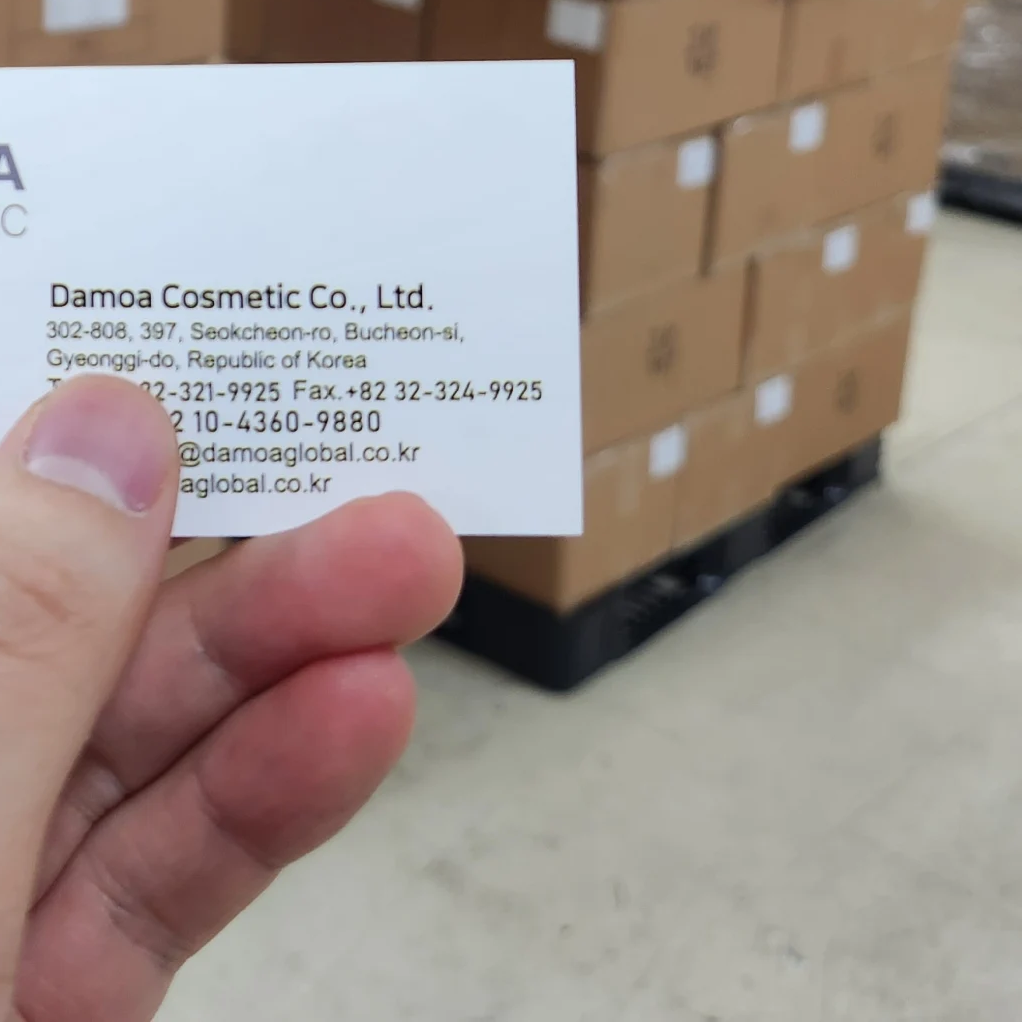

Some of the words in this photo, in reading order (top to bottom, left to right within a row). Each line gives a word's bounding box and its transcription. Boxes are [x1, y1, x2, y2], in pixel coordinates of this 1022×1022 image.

[51, 283, 153, 309] Damoa
[161, 281, 301, 310] Cosmetic
[309, 283, 366, 314] Co.,
[377, 283, 433, 310] Ltd.
[46, 321, 133, 343] 302-808,
[140, 321, 183, 343] 397,
[190, 321, 337, 344] Seokcheon-ro,
[344, 321, 464, 343] Bucheon-si,
[46, 348, 180, 372] Gyeonggi-do,
[187, 349, 275, 373] Republic
[281, 349, 302, 370] of
[307, 349, 367, 370] Korea
[394, 379, 543, 402] 32-324-9925
[194, 409, 381, 434] 10-4360-9880
[177, 441, 420, 468] @damoaglobal.co.kr
[180, 472, 332, 499] aglobal.co.kr
